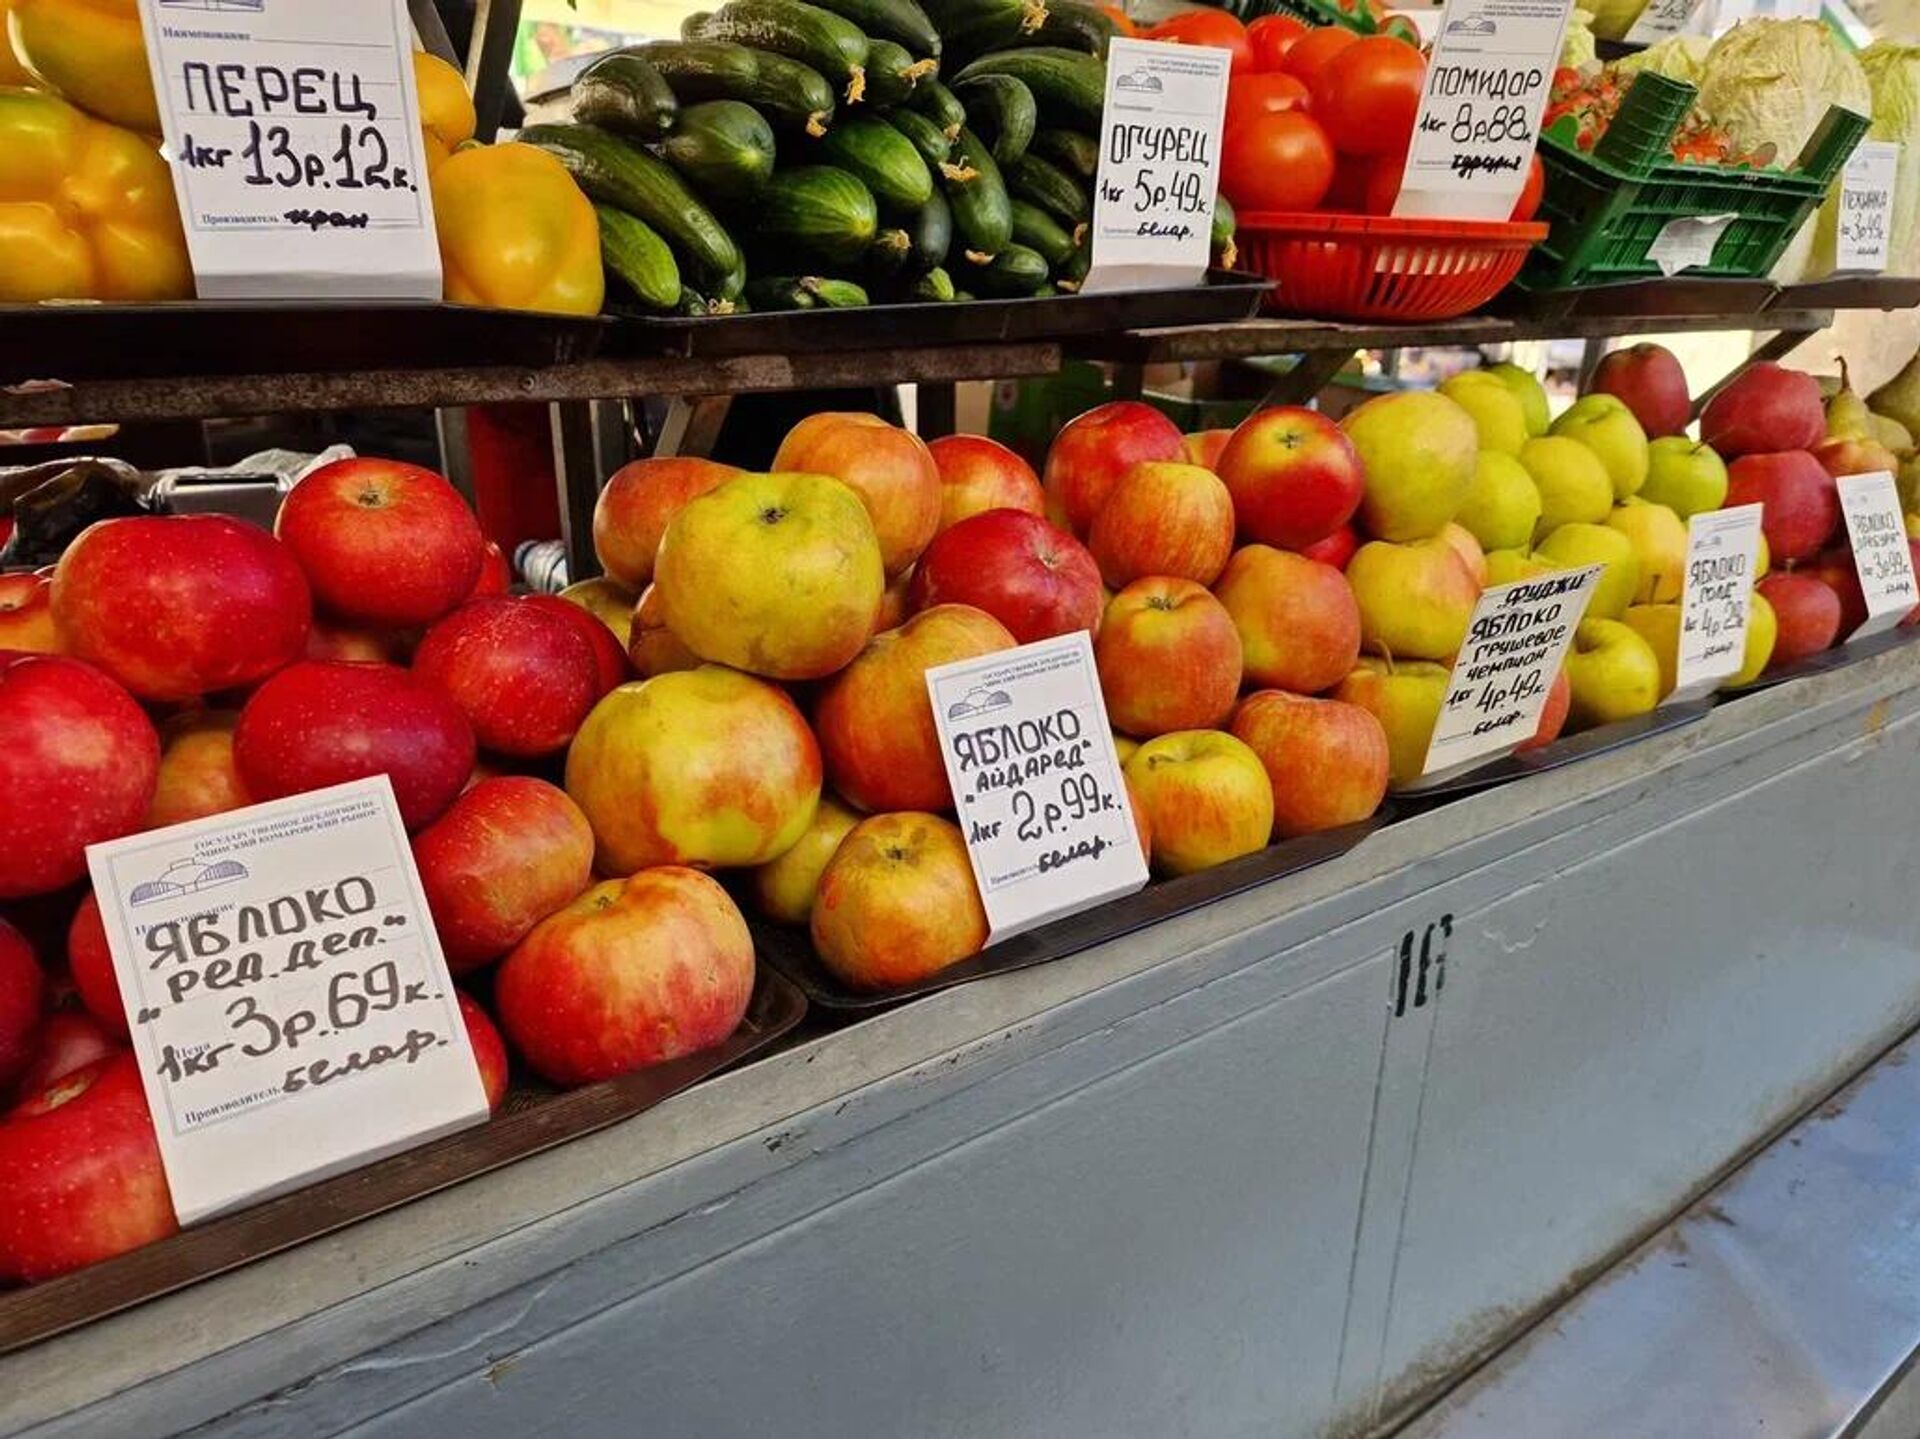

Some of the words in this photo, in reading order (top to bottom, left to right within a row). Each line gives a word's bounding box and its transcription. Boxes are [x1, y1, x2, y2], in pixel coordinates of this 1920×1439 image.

[183, 62, 377, 120] ПЕРЕЦ
[1430, 66, 1543, 99] ПОМИДОР
[1419, 112, 1447, 132] 1кг
[179, 133, 233, 168] 1кг
[1110, 124, 1209, 167] ОГУРЕЦ
[1468, 603, 1561, 645] ЯБЛОКО
[954, 709, 1080, 771] ЯБЛОКО
[969, 821, 1002, 845] 1кг
[145, 876, 376, 970] ЯБЛОКО
[157, 1042, 234, 1082] 1кг
